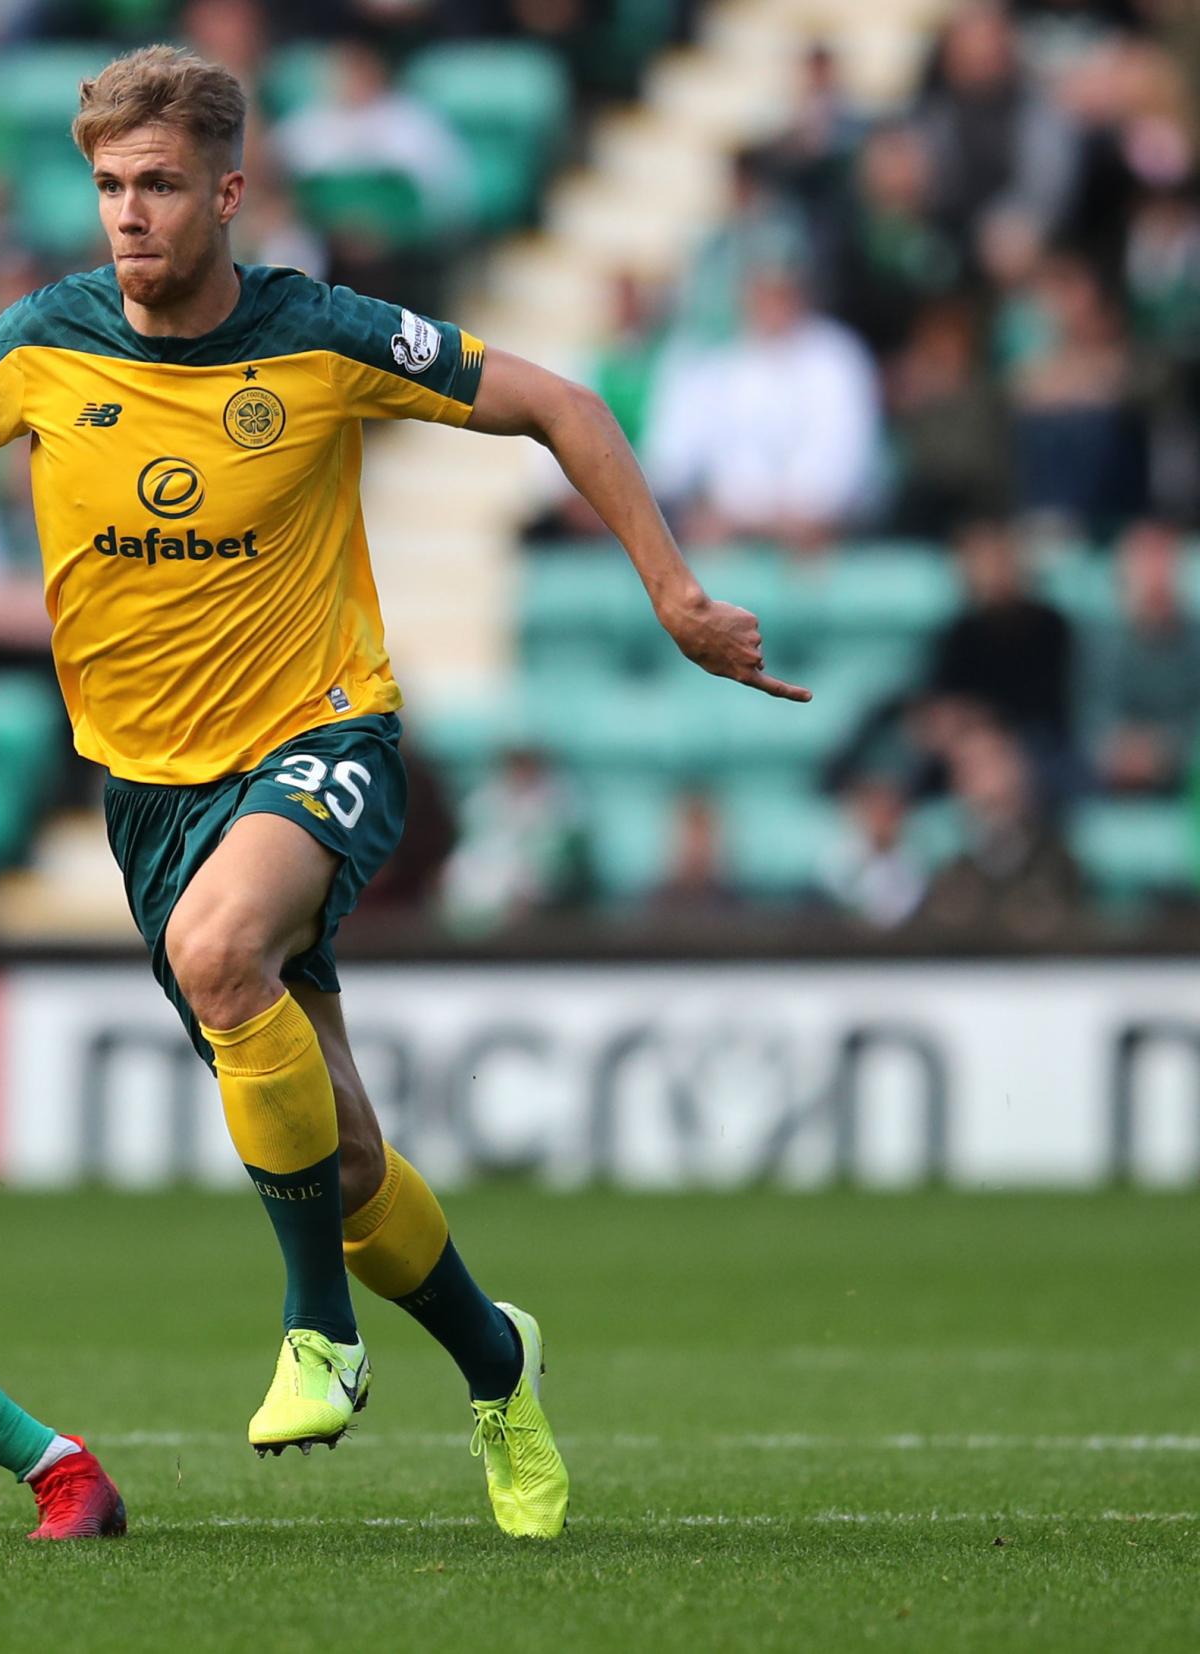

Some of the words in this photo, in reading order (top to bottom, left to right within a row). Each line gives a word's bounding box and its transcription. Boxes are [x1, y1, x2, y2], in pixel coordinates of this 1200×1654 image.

[93, 526, 258, 565] dafabet
[274, 754, 372, 829] 35
[255, 1181, 322, 1201] CELTIC
